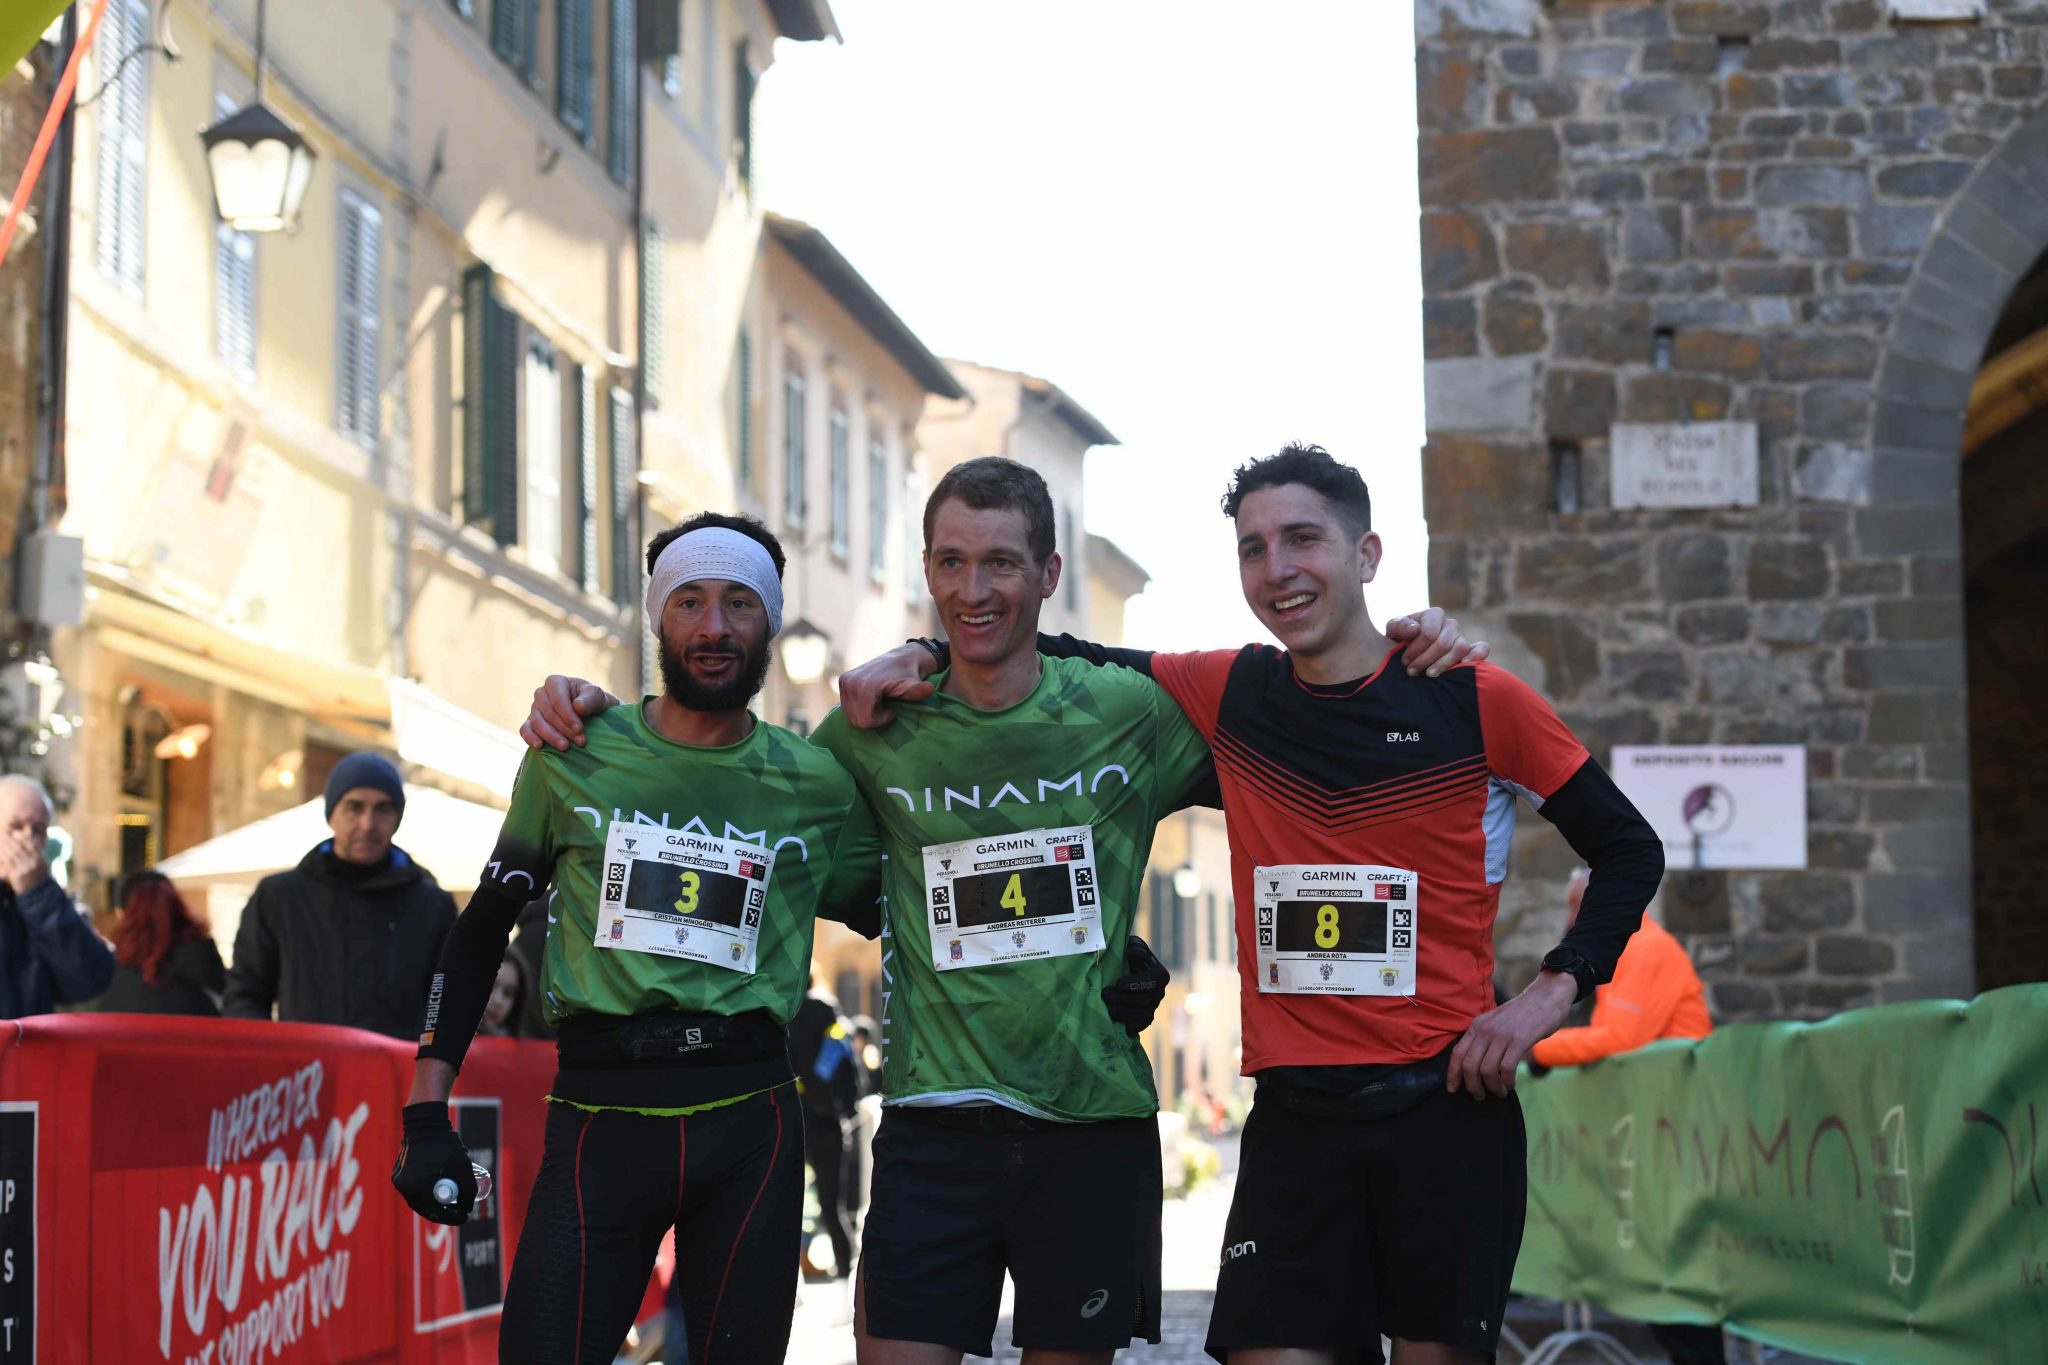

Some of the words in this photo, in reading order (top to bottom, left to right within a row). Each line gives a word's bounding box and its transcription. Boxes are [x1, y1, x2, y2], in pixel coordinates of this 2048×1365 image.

[666, 835, 724, 854] GARMIN
[976, 838, 1035, 854] GARMIN
[1045, 835, 1078, 845] CRAFT
[661, 852, 694, 864] BRUNELLO
[695, 859, 727, 870] CROSSING
[734, 848, 763, 862] CRAFT
[976, 860, 1010, 870] BRUNELLO
[1010, 856, 1042, 866] CROSSING
[1302, 872, 1356, 881] GARMIN
[1367, 873, 1402, 882] CRAFT
[674, 871, 700, 914] 3
[1000, 873, 1026, 916] 4
[654, 913, 682, 923] CRISTIAN
[683, 917, 713, 928] MINOGGIO
[987, 921, 1016, 930] ANDREAS
[1016, 918, 1046, 927] REITERER
[1314, 904, 1340, 949] 8
[425, 973, 445, 1031] PERUCCHINI
[206, 1058, 324, 1174] WHEREVER
[159, 1173, 253, 1360] YOU
[254, 1101, 370, 1284] RACE
[218, 1272, 308, 1365] SUPPORT
[309, 1251, 350, 1328] YOU
